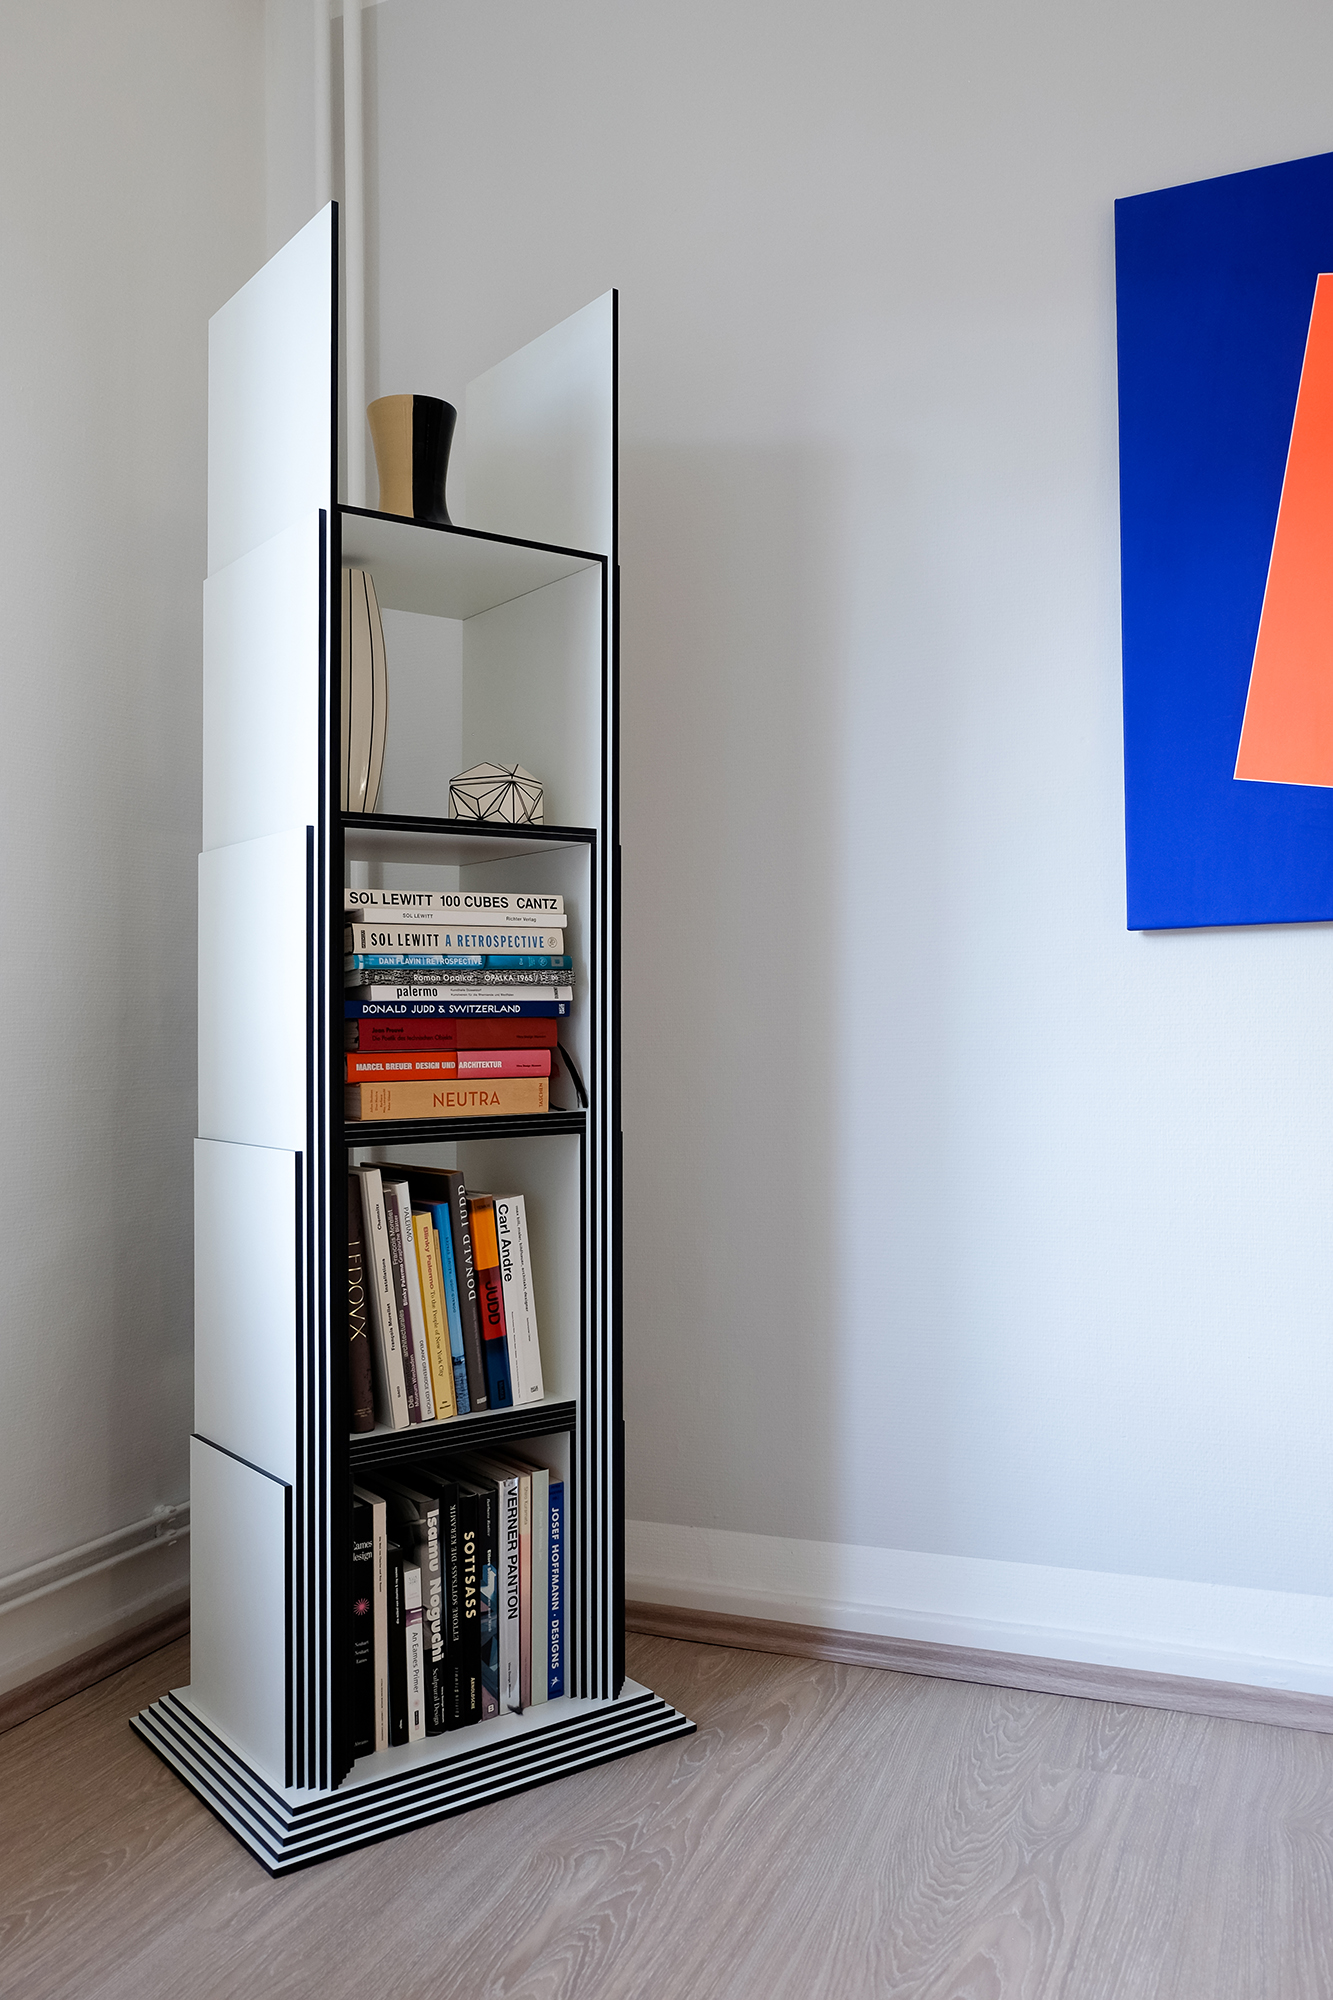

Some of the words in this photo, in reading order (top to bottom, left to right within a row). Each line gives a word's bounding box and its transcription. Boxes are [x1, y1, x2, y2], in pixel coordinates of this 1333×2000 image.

[349, 892, 378, 904] SOL
[382, 893, 433, 906] LEWITT
[440, 896, 460, 907] 100
[464, 896, 509, 908] CUBES
[516, 897, 557, 910] CANTZ
[371, 933, 393, 946] SOL
[398, 934, 439, 946] LEWITT
[445, 934, 452, 946] A
[457, 934, 544, 948] RETROSPECTIVE
[362, 1004, 407, 1013] DONALD
[411, 1005, 435, 1013] JUDD
[449, 1004, 520, 1014] SWITZERLAND
[396, 986, 438, 999] palermo
[433, 1091, 500, 1108] NEUTRA
[404, 1206, 412, 1242] PALERMO
[458, 1185, 469, 1227] JUDD
[498, 1204, 510, 1234] Carl
[462, 1234, 476, 1301] DONALD
[501, 1239, 513, 1282] Andre
[485, 1281, 500, 1325] JUDD
[507, 1486, 517, 1552] VERNER
[427, 1509, 439, 1571] Isamu
[464, 1532, 477, 1619] SOTTSASS
[507, 1555, 518, 1620] PANTON
[412, 1632, 418, 1642] An
[426, 1577, 444, 1663] Noguchi
[432, 1668, 440, 1701] Sculptural
